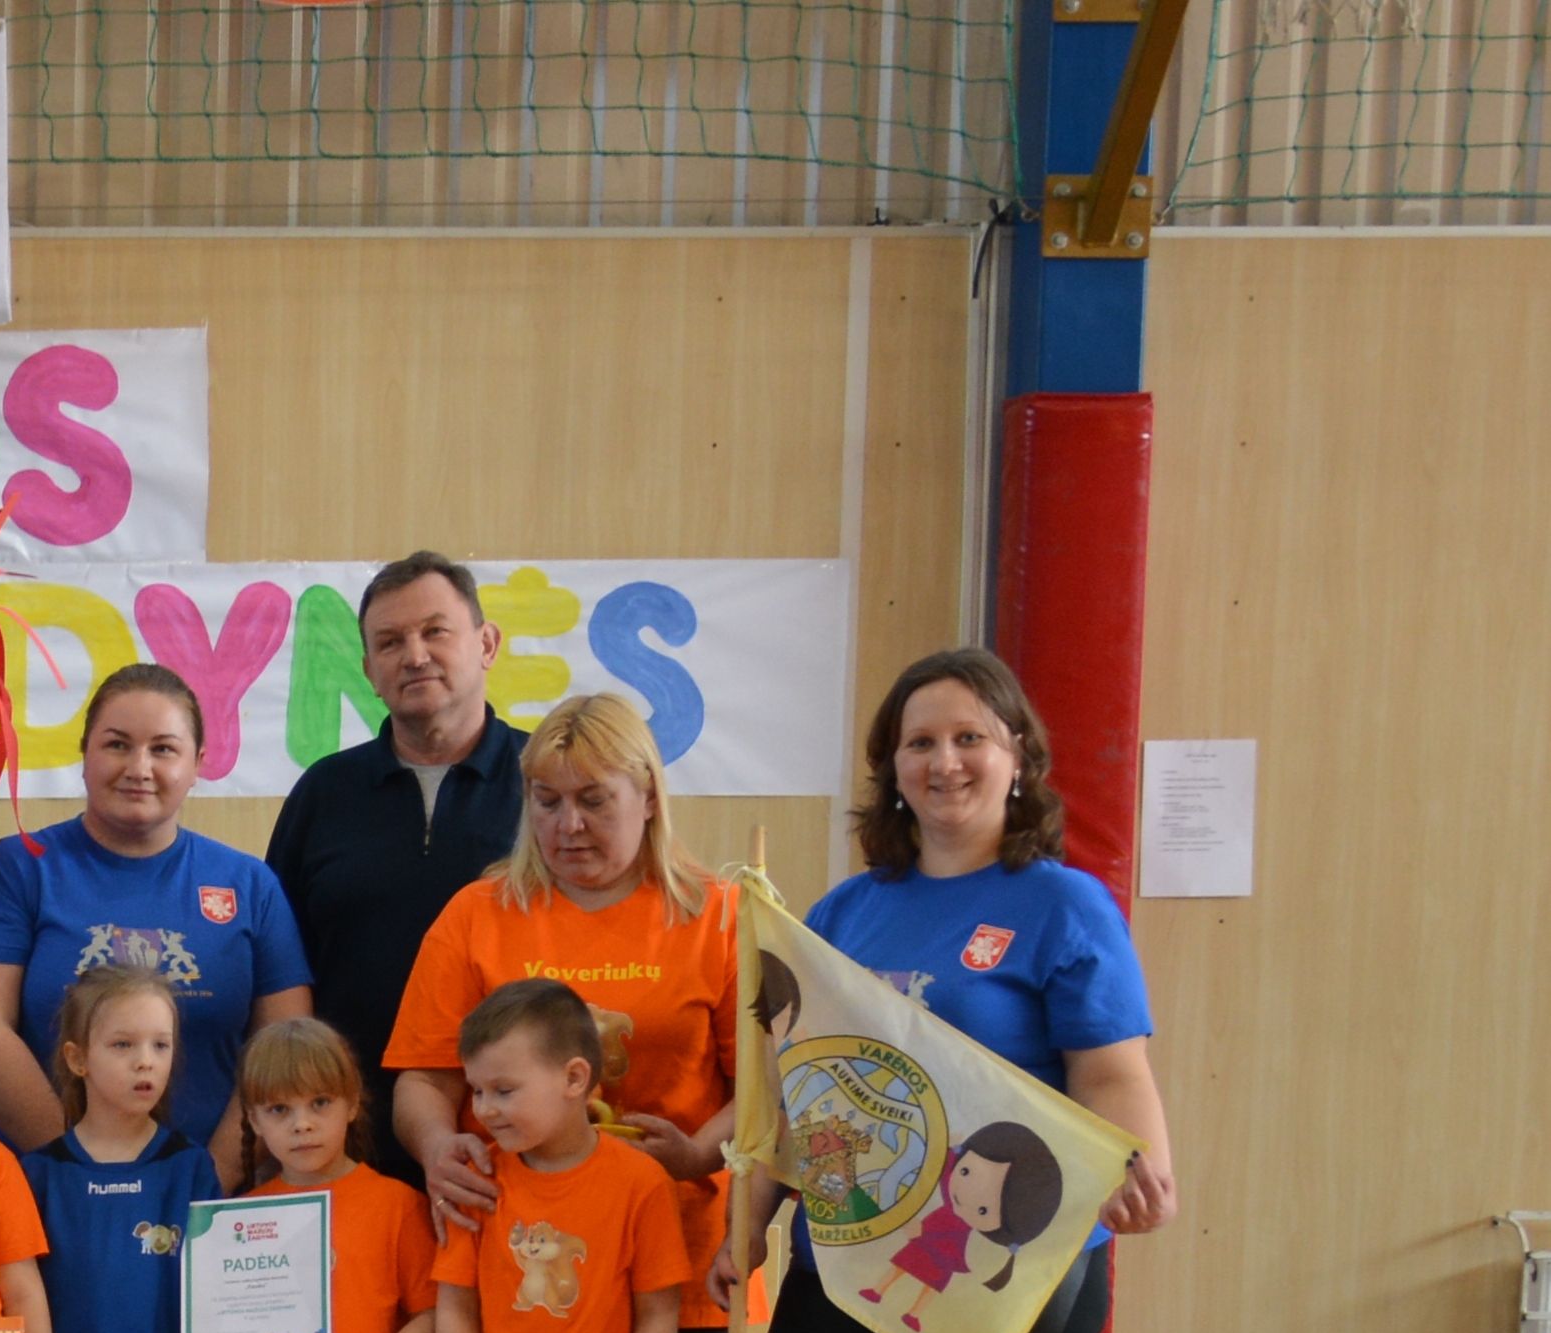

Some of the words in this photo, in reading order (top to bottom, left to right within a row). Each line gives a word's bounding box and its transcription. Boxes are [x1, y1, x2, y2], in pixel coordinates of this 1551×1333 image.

[858, 1041, 929, 1095] VARĖNOS
[829, 1063, 870, 1105] AUKIME
[870, 1100, 914, 1122] SVEIKI
[88, 1179, 142, 1195] hummel
[223, 1253, 291, 1273] PADĖKA
